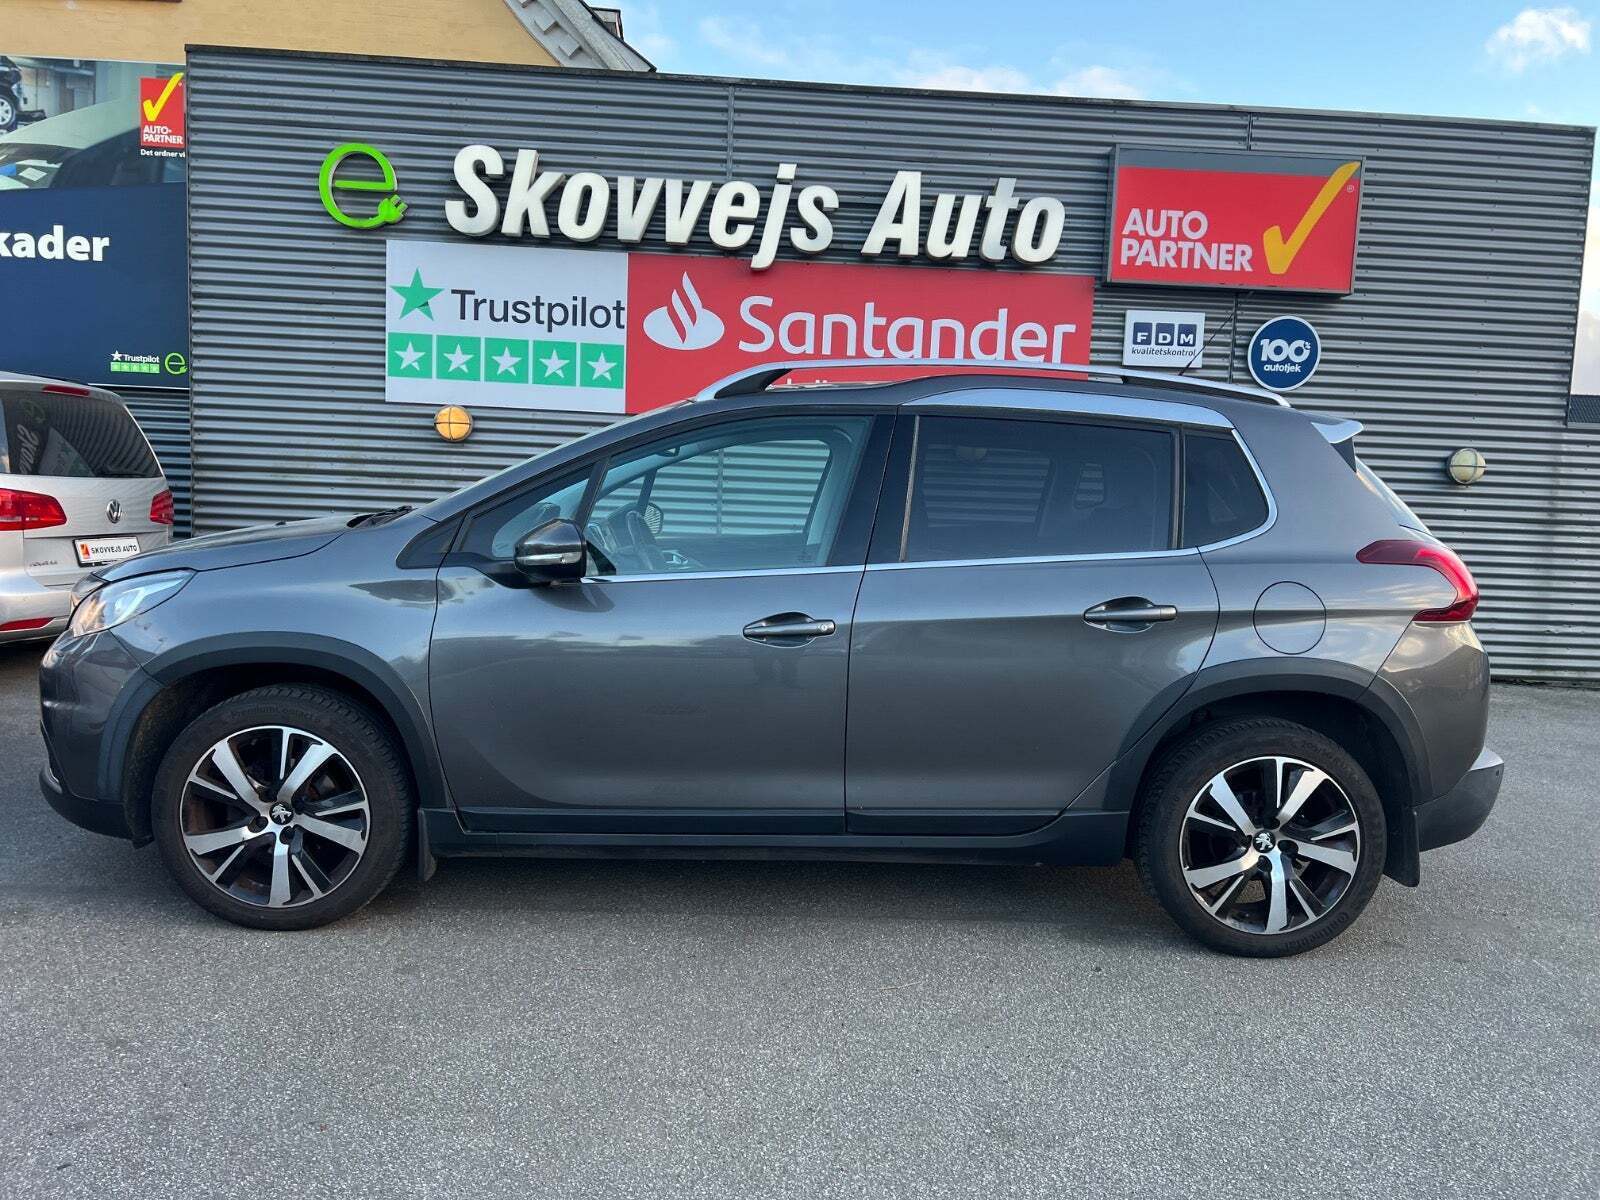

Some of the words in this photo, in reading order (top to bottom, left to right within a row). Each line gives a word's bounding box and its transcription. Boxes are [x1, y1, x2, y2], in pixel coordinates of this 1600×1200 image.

[143, 133, 184, 145] PARTNER
[154, 150, 178, 158] ordner
[445, 144, 839, 271] Skovvejs
[861, 170, 1066, 263] Auto
[1121, 208, 1208, 240] AUTO
[1120, 238, 1253, 272] PARTNER
[451, 289, 626, 333] Trustpilot
[738, 295, 1077, 364] Santander
[1131, 347, 1196, 357] kvalitetskontrol
[123, 354, 160, 364] Trustpilot
[1263, 363, 1302, 374] autotjek
[91, 545, 122, 554] SKOVVEJS
[123, 544, 138, 552] AUTO
